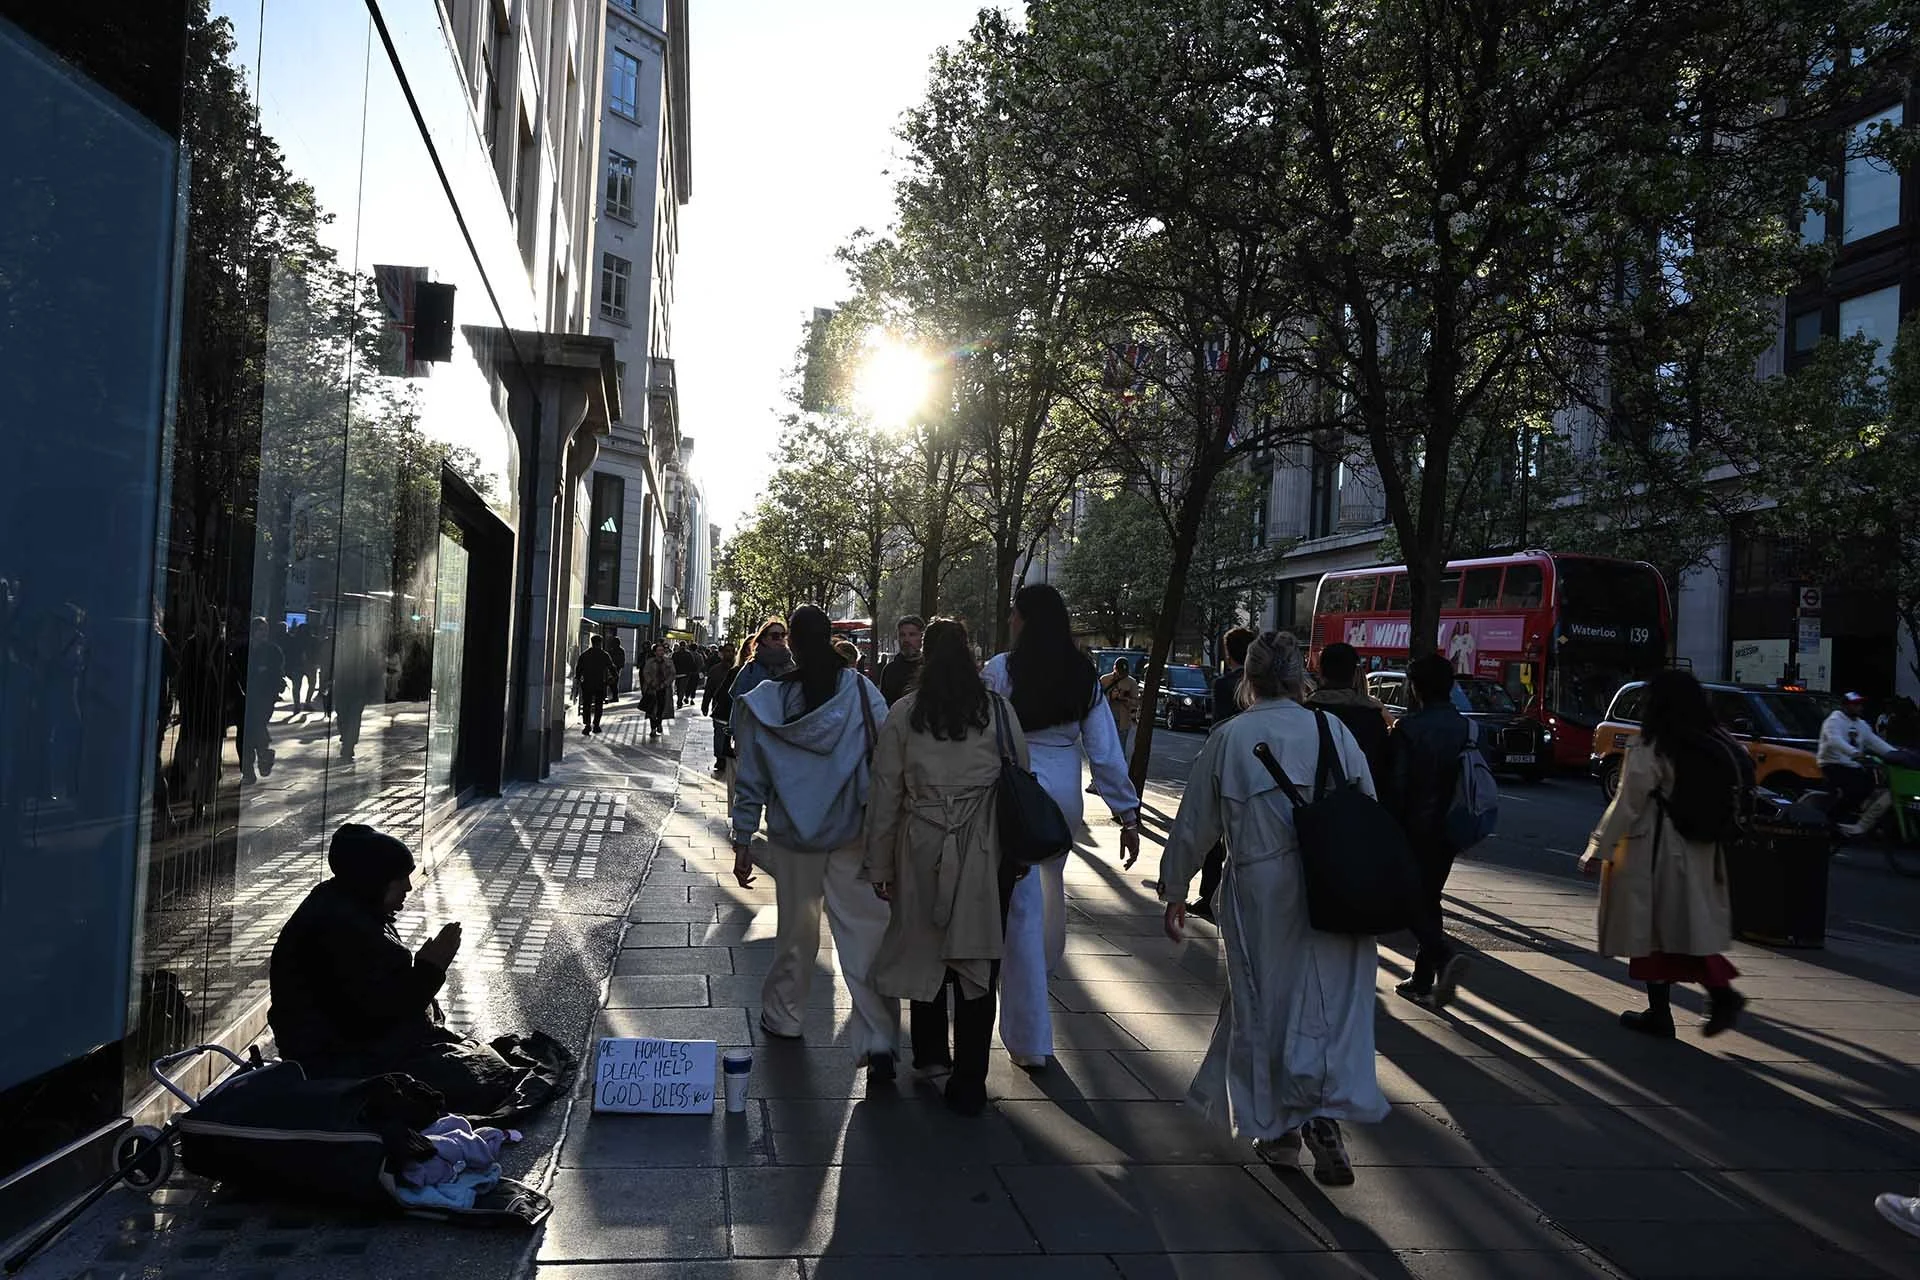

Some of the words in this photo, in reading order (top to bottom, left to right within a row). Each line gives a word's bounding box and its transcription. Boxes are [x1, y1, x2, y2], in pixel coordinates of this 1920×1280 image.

[1571, 624, 1616, 638] Waterloo
[1630, 627, 1649, 642] 139
[635, 1041, 690, 1061] HOMLES
[654, 1060, 693, 1078] HELP
